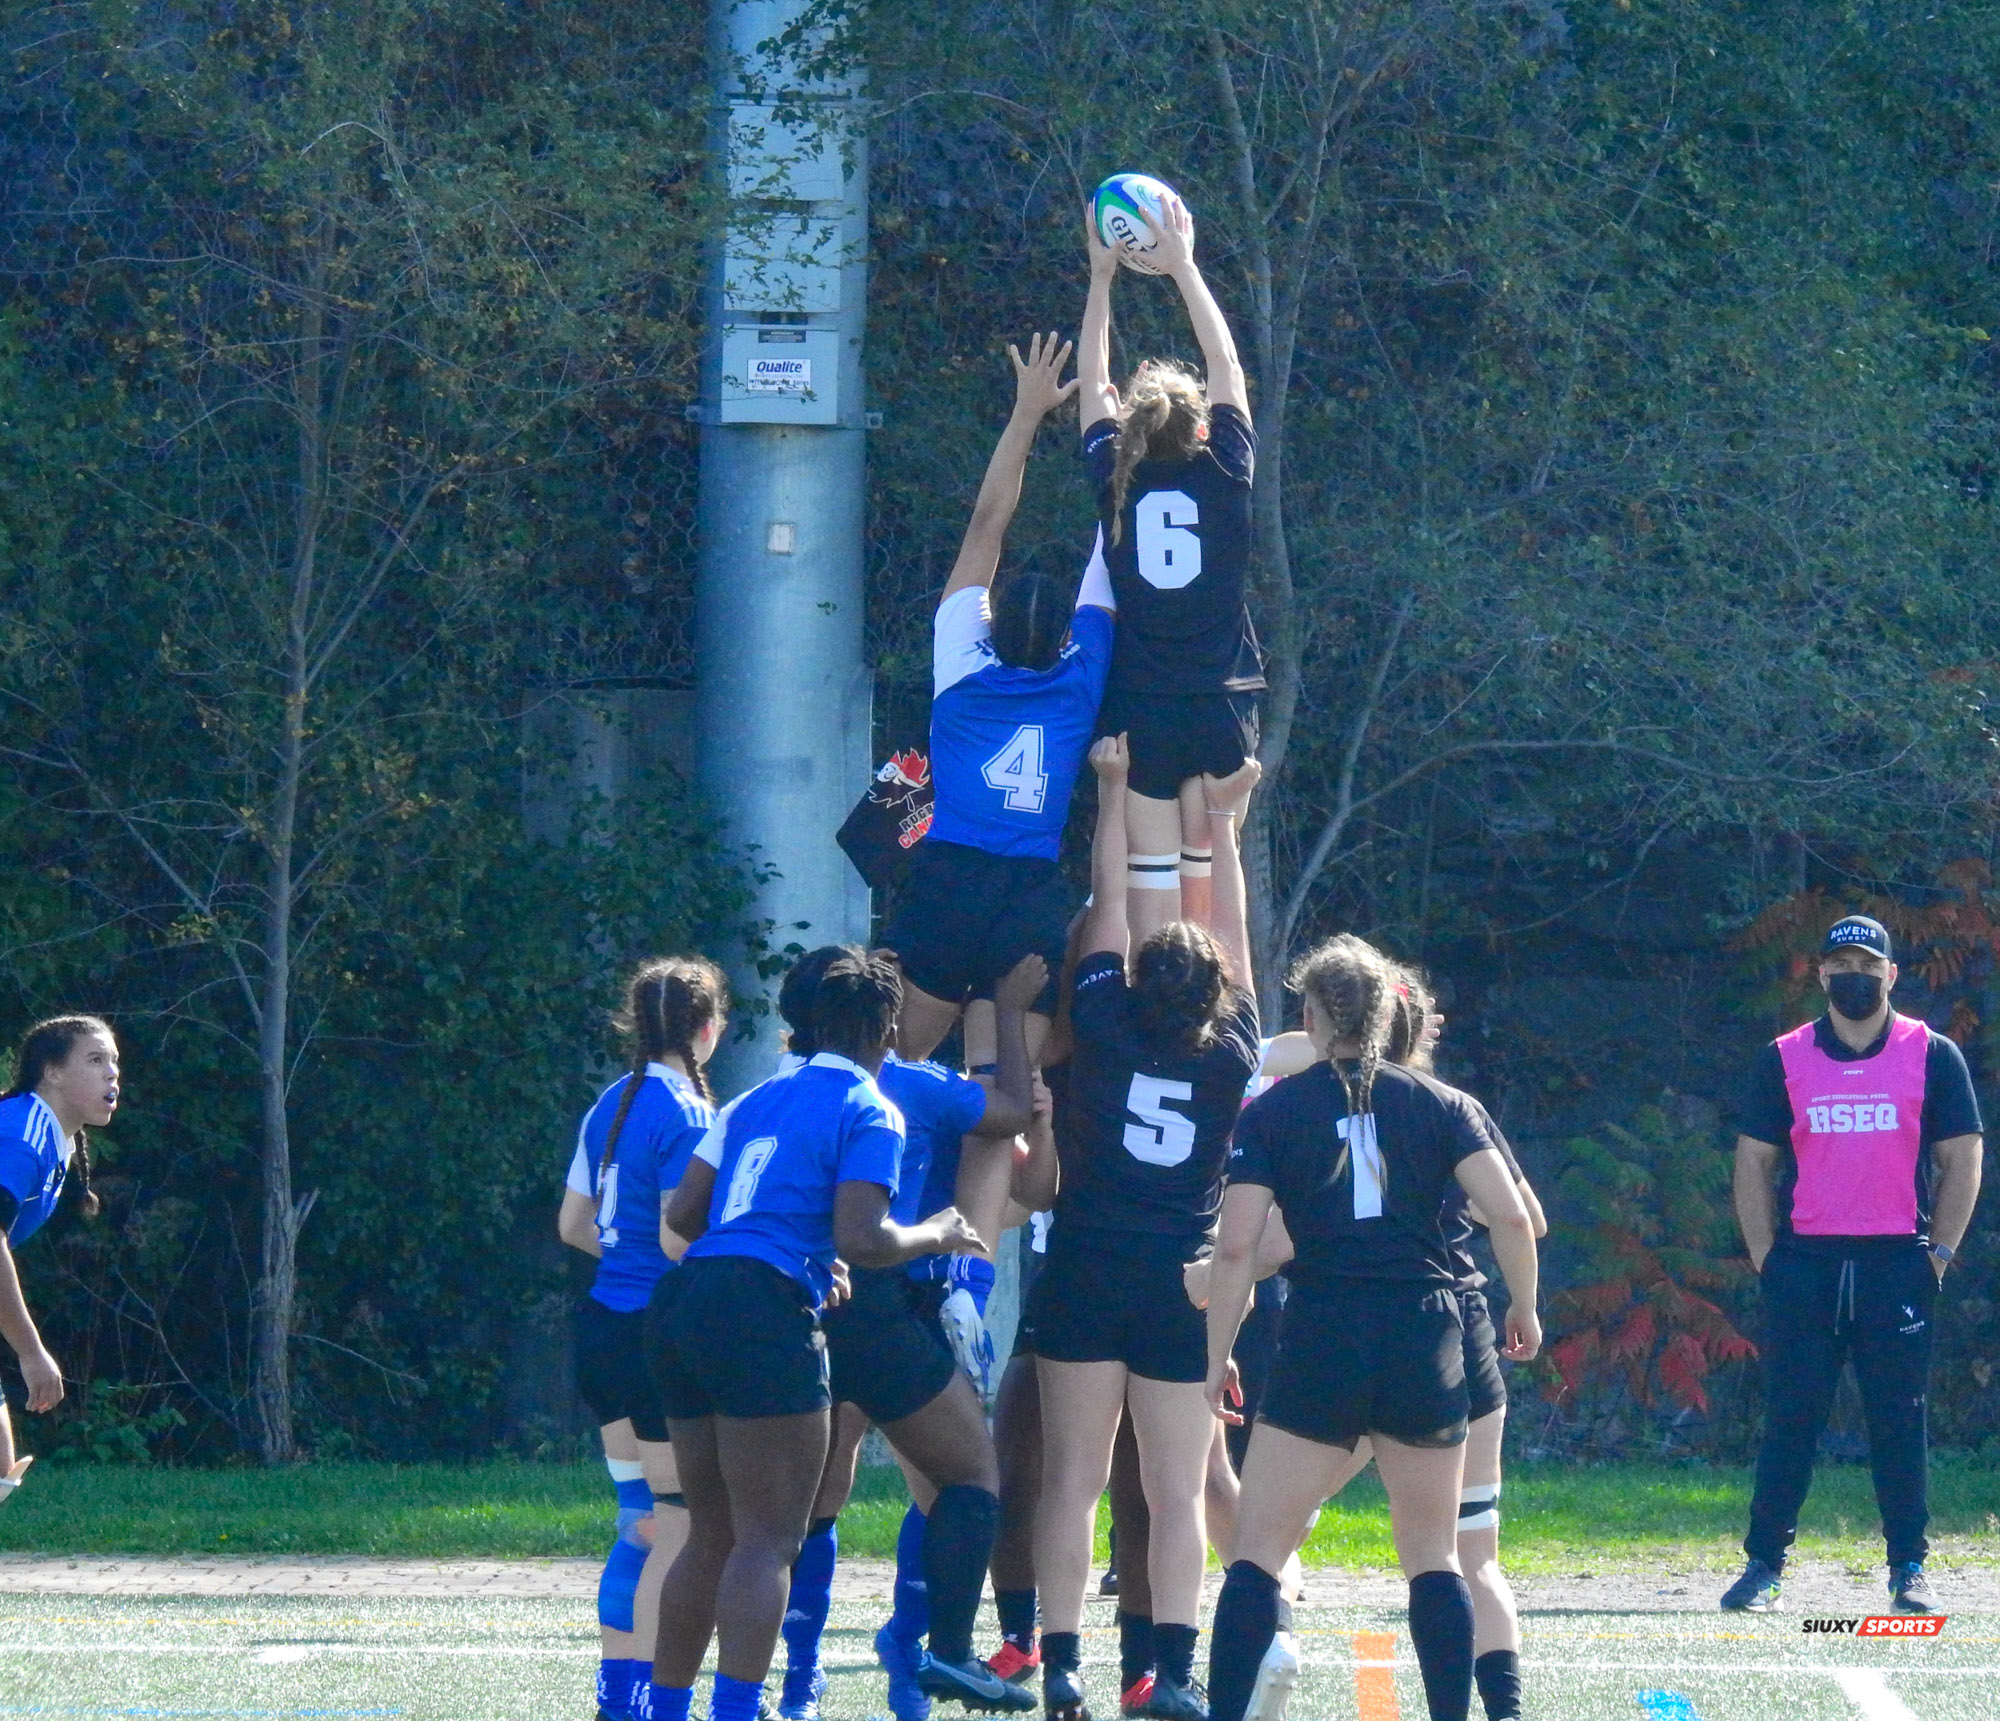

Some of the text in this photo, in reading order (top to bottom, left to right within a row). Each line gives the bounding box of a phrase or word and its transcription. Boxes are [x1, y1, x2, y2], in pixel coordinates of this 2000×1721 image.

[757, 361, 802, 373] Qualite
[1136, 490, 1202, 589] 6
[981, 724, 1049, 814] 4
[1830, 926, 1877, 940] RAVENS
[1122, 1072, 1196, 1168] 5
[1806, 1103, 1899, 1133] RSEQ
[720, 1136, 779, 1224] 8
[1336, 1112, 1383, 1220] 1
